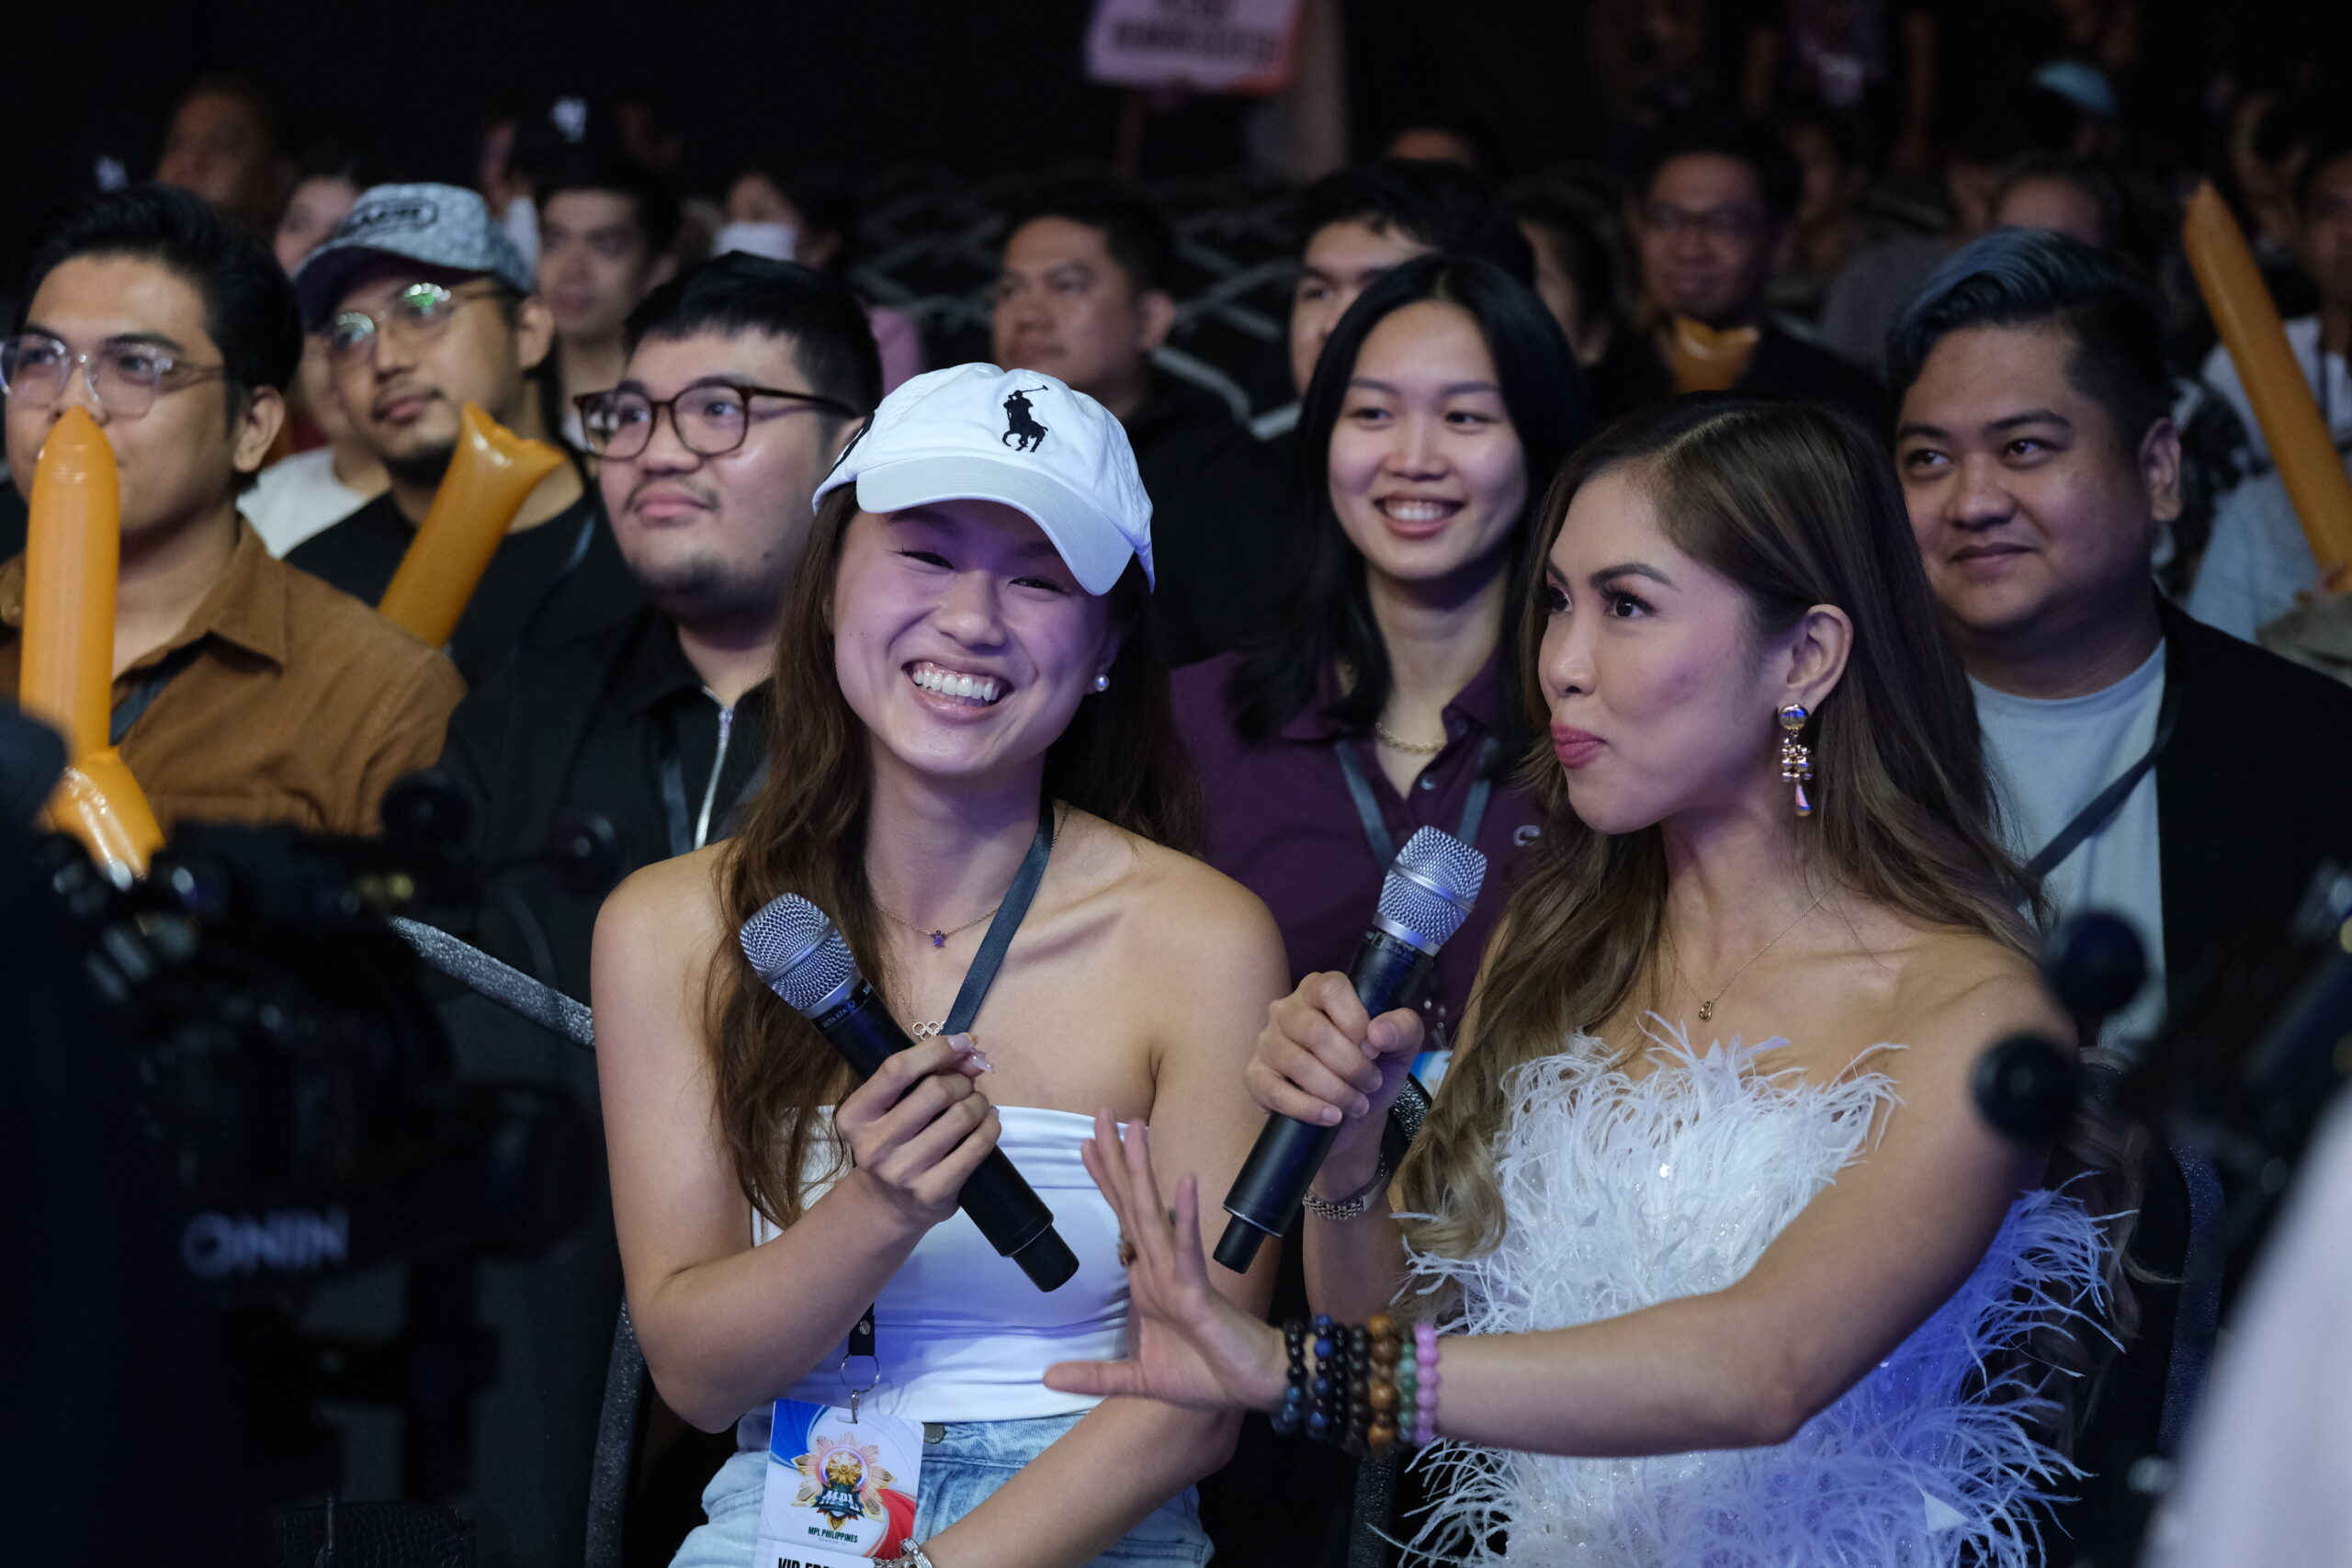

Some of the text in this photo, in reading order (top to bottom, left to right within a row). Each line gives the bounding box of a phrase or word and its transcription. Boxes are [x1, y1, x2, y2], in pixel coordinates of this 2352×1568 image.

[819, 1489, 860, 1512] MPL
[808, 1526, 820, 1537] MPL
[820, 1529, 858, 1543] PHILIPPINES
